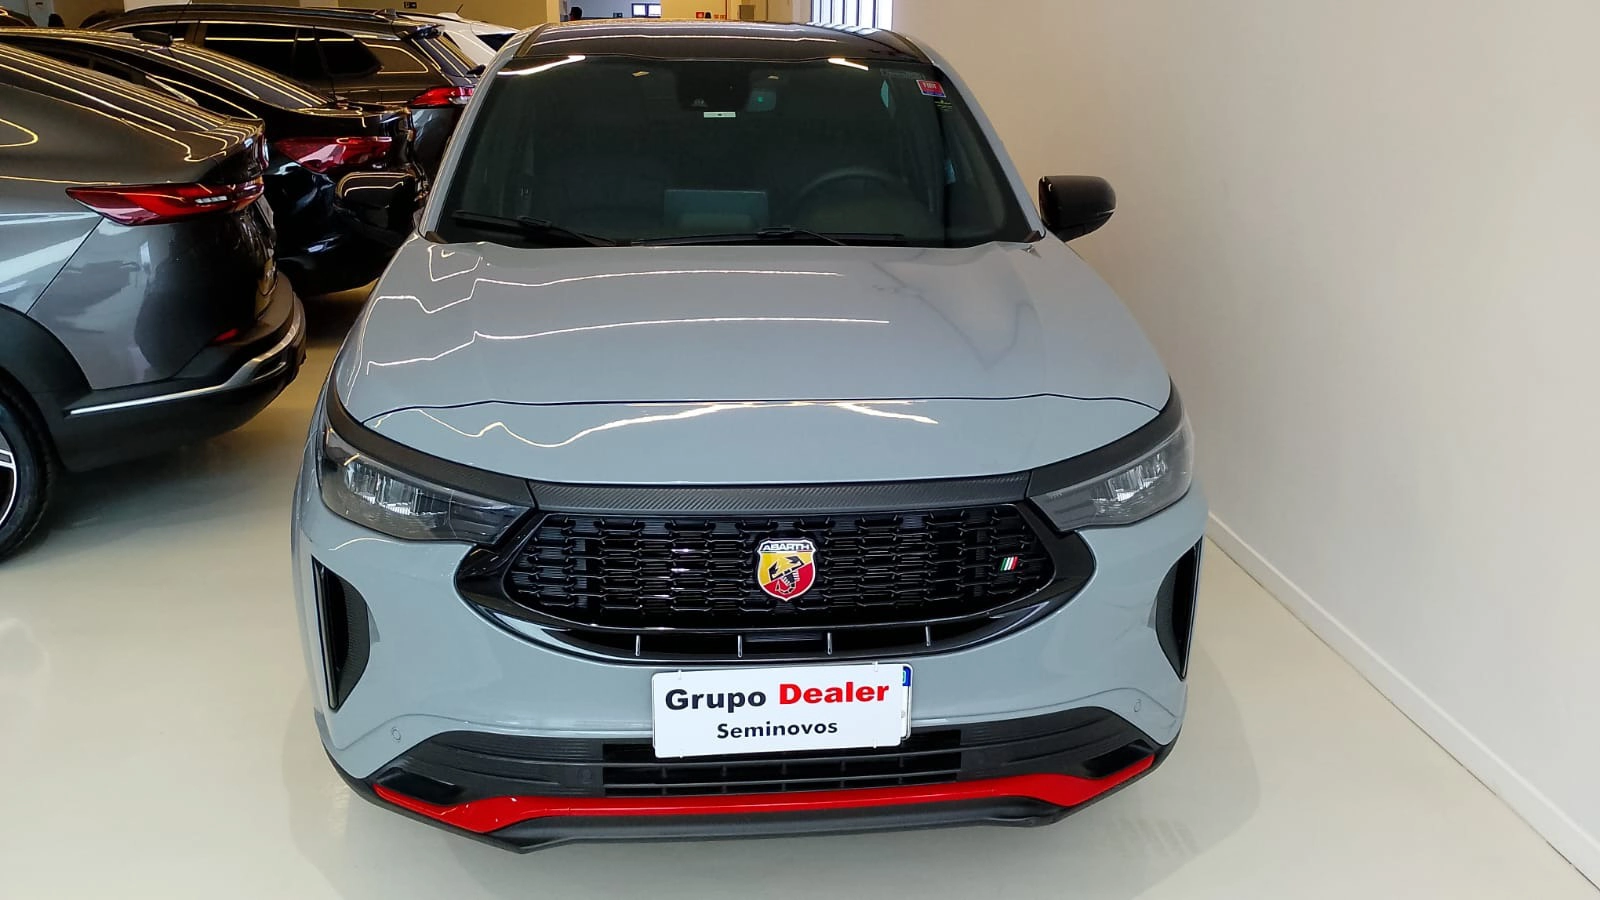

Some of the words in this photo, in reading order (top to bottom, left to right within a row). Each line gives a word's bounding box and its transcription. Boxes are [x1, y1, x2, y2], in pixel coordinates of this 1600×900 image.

[763, 543, 810, 551] ABARTH
[665, 688, 767, 713] Grupo
[779, 681, 890, 705] Dealer
[716, 720, 838, 739] Seminovos
